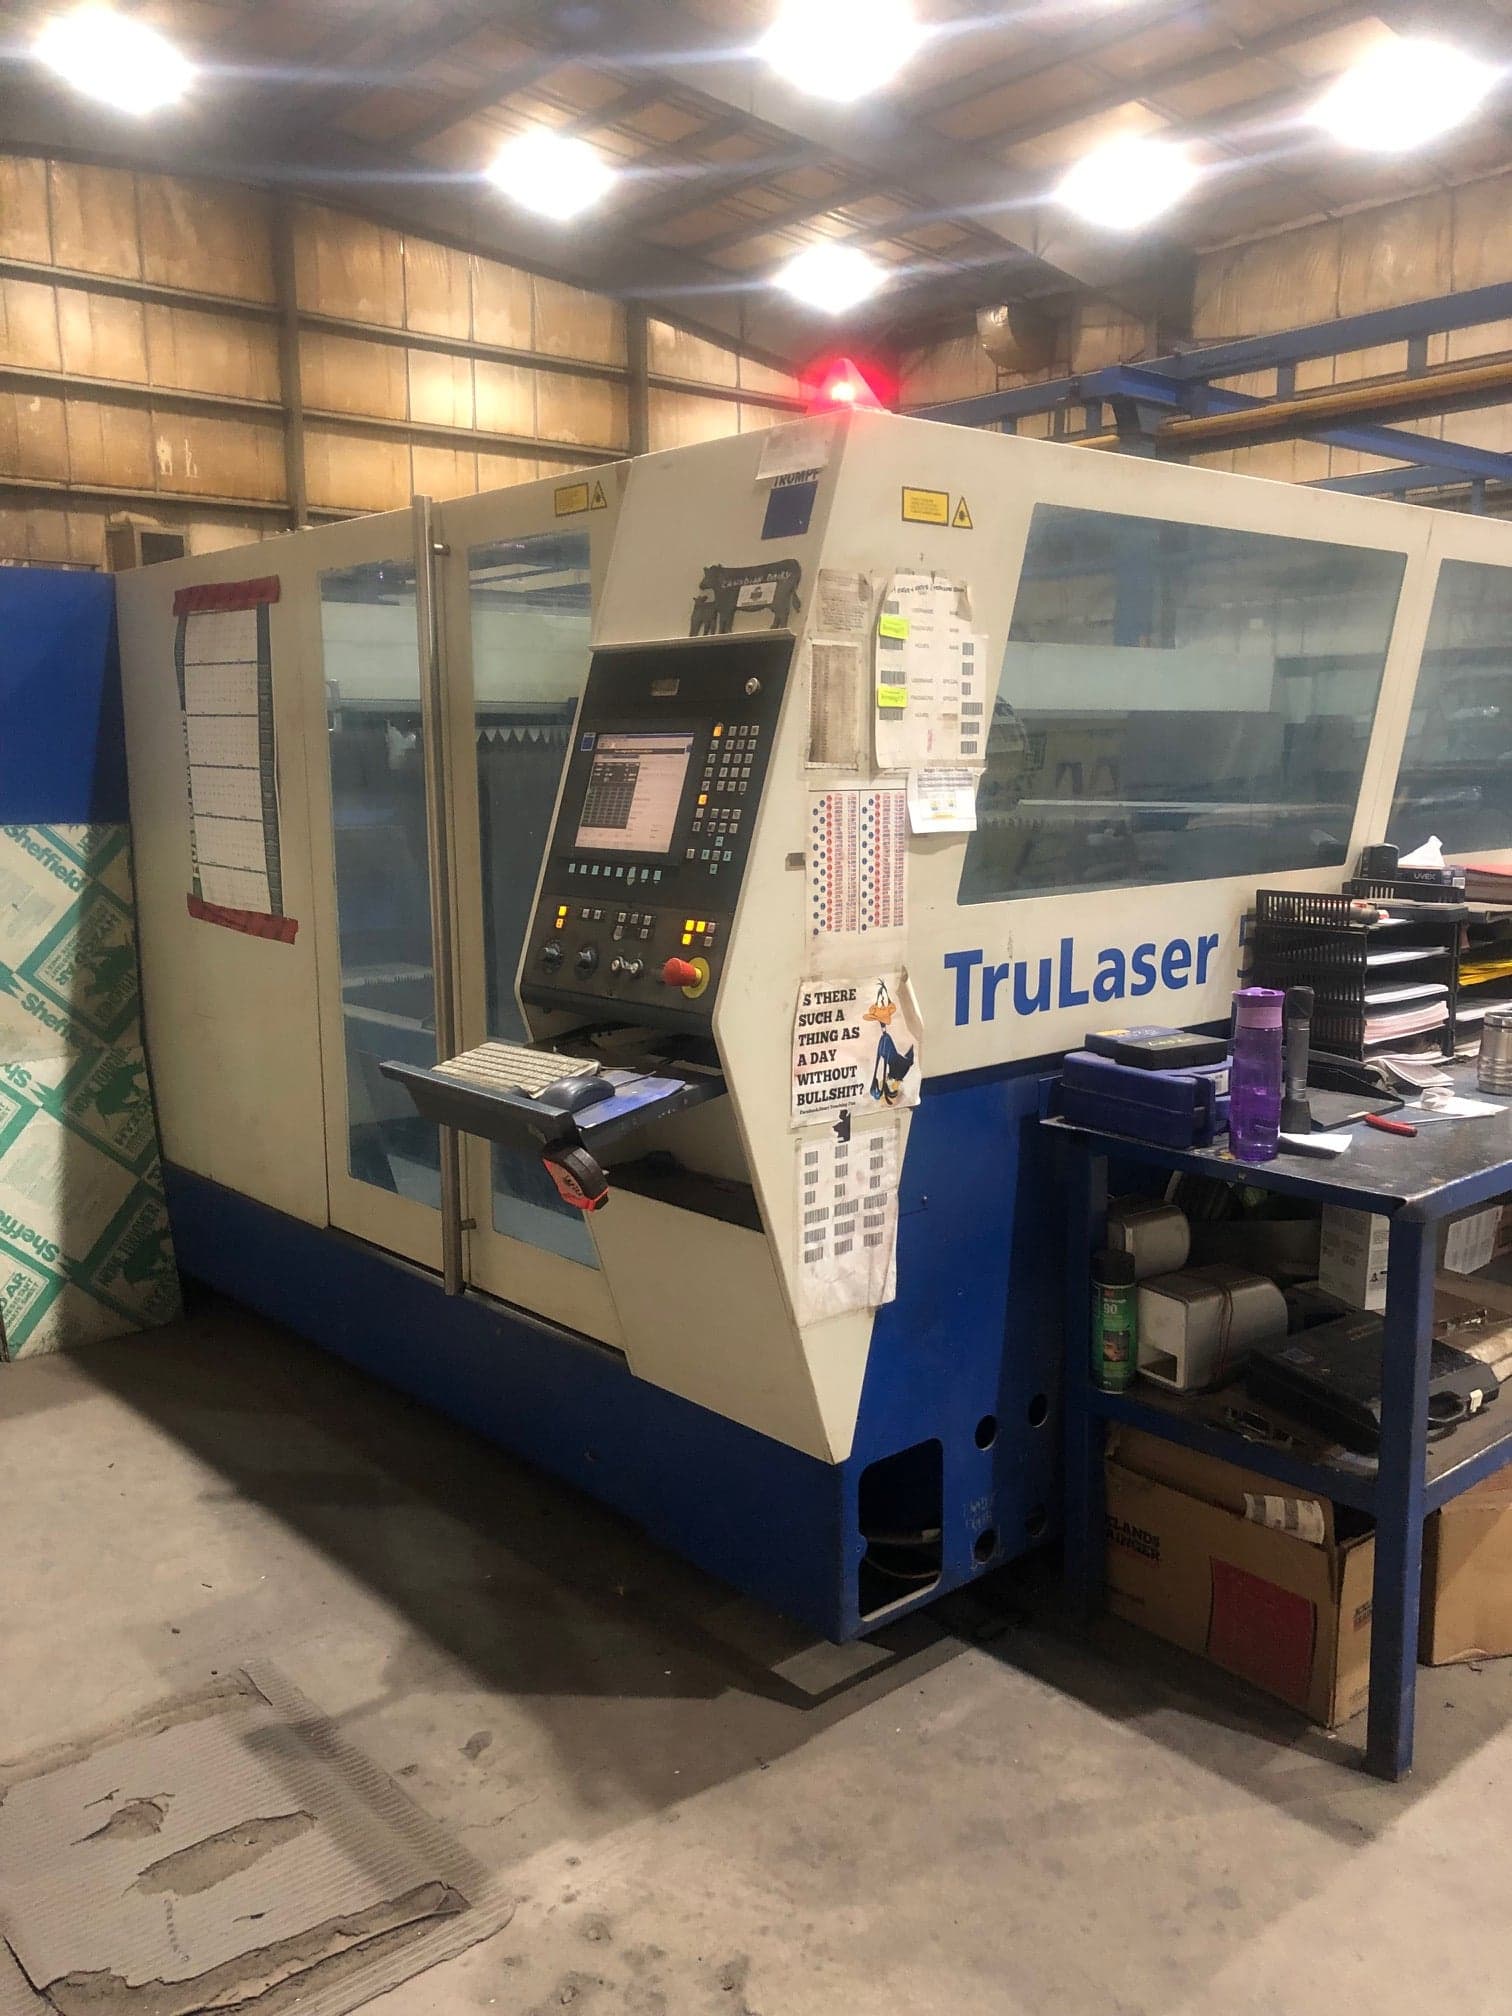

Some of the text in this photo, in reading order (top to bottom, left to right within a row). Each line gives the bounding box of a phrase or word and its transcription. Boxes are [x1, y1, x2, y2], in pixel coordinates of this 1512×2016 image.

[944, 932, 1218, 1026] TruLaser
[814, 988, 856, 1004] THERE
[798, 1009, 845, 1027] SUCH A
[798, 1026, 860, 1046] THING AS
[797, 1049, 837, 1066] A DAY
[797, 1065, 857, 1086] WITHOUT
[797, 1083, 864, 1106] BULLSHIT?
[1103, 1303, 1117, 1314] 90
